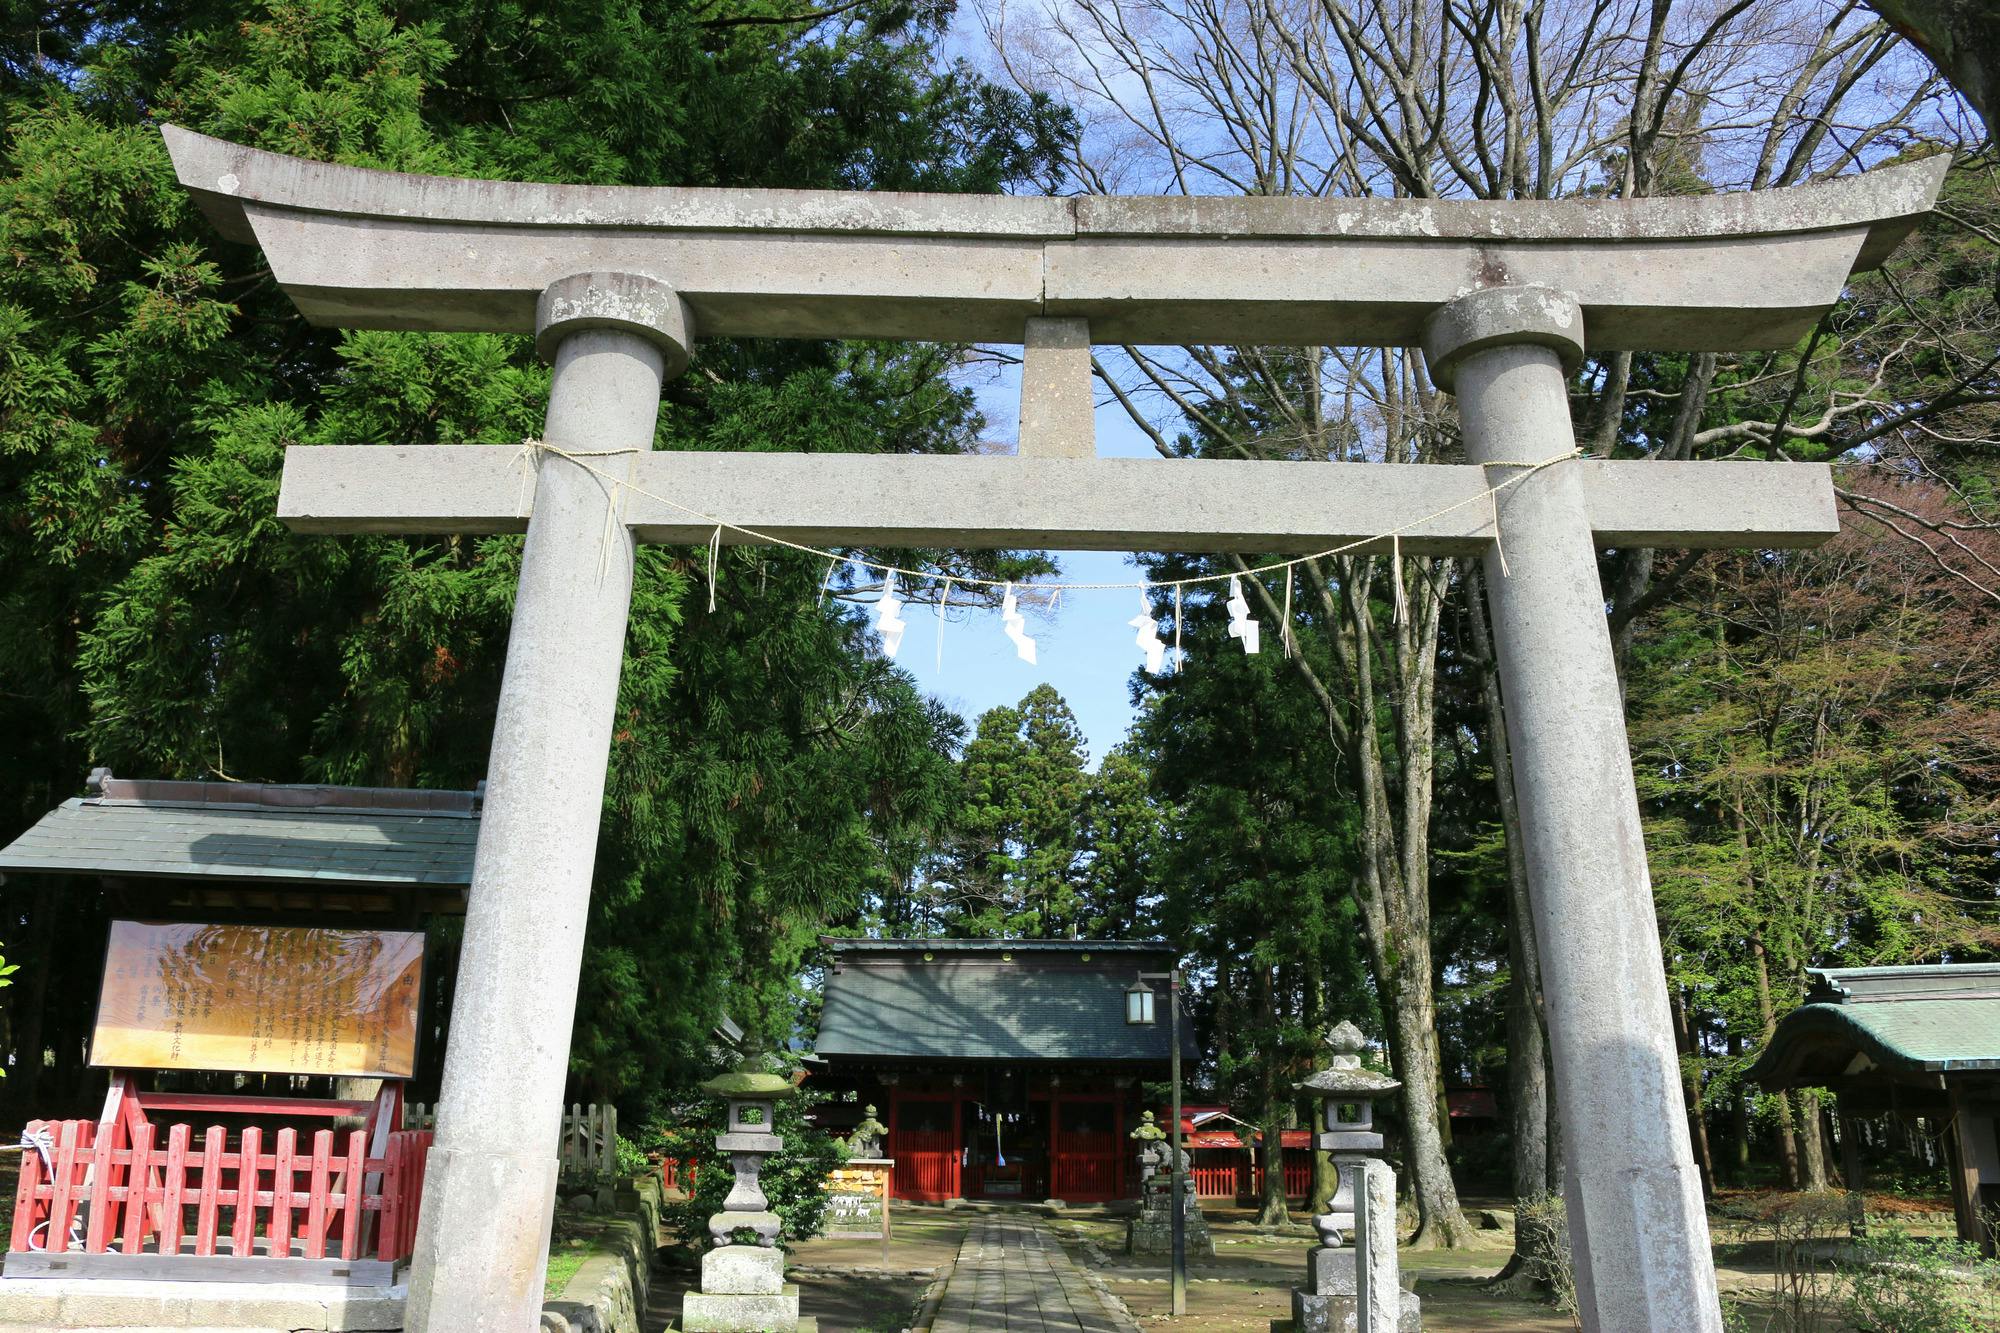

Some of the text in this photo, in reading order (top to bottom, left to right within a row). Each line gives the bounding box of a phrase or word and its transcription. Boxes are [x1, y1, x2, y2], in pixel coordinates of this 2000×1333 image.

[171, 1022, 184, 1061] 無形文化財
